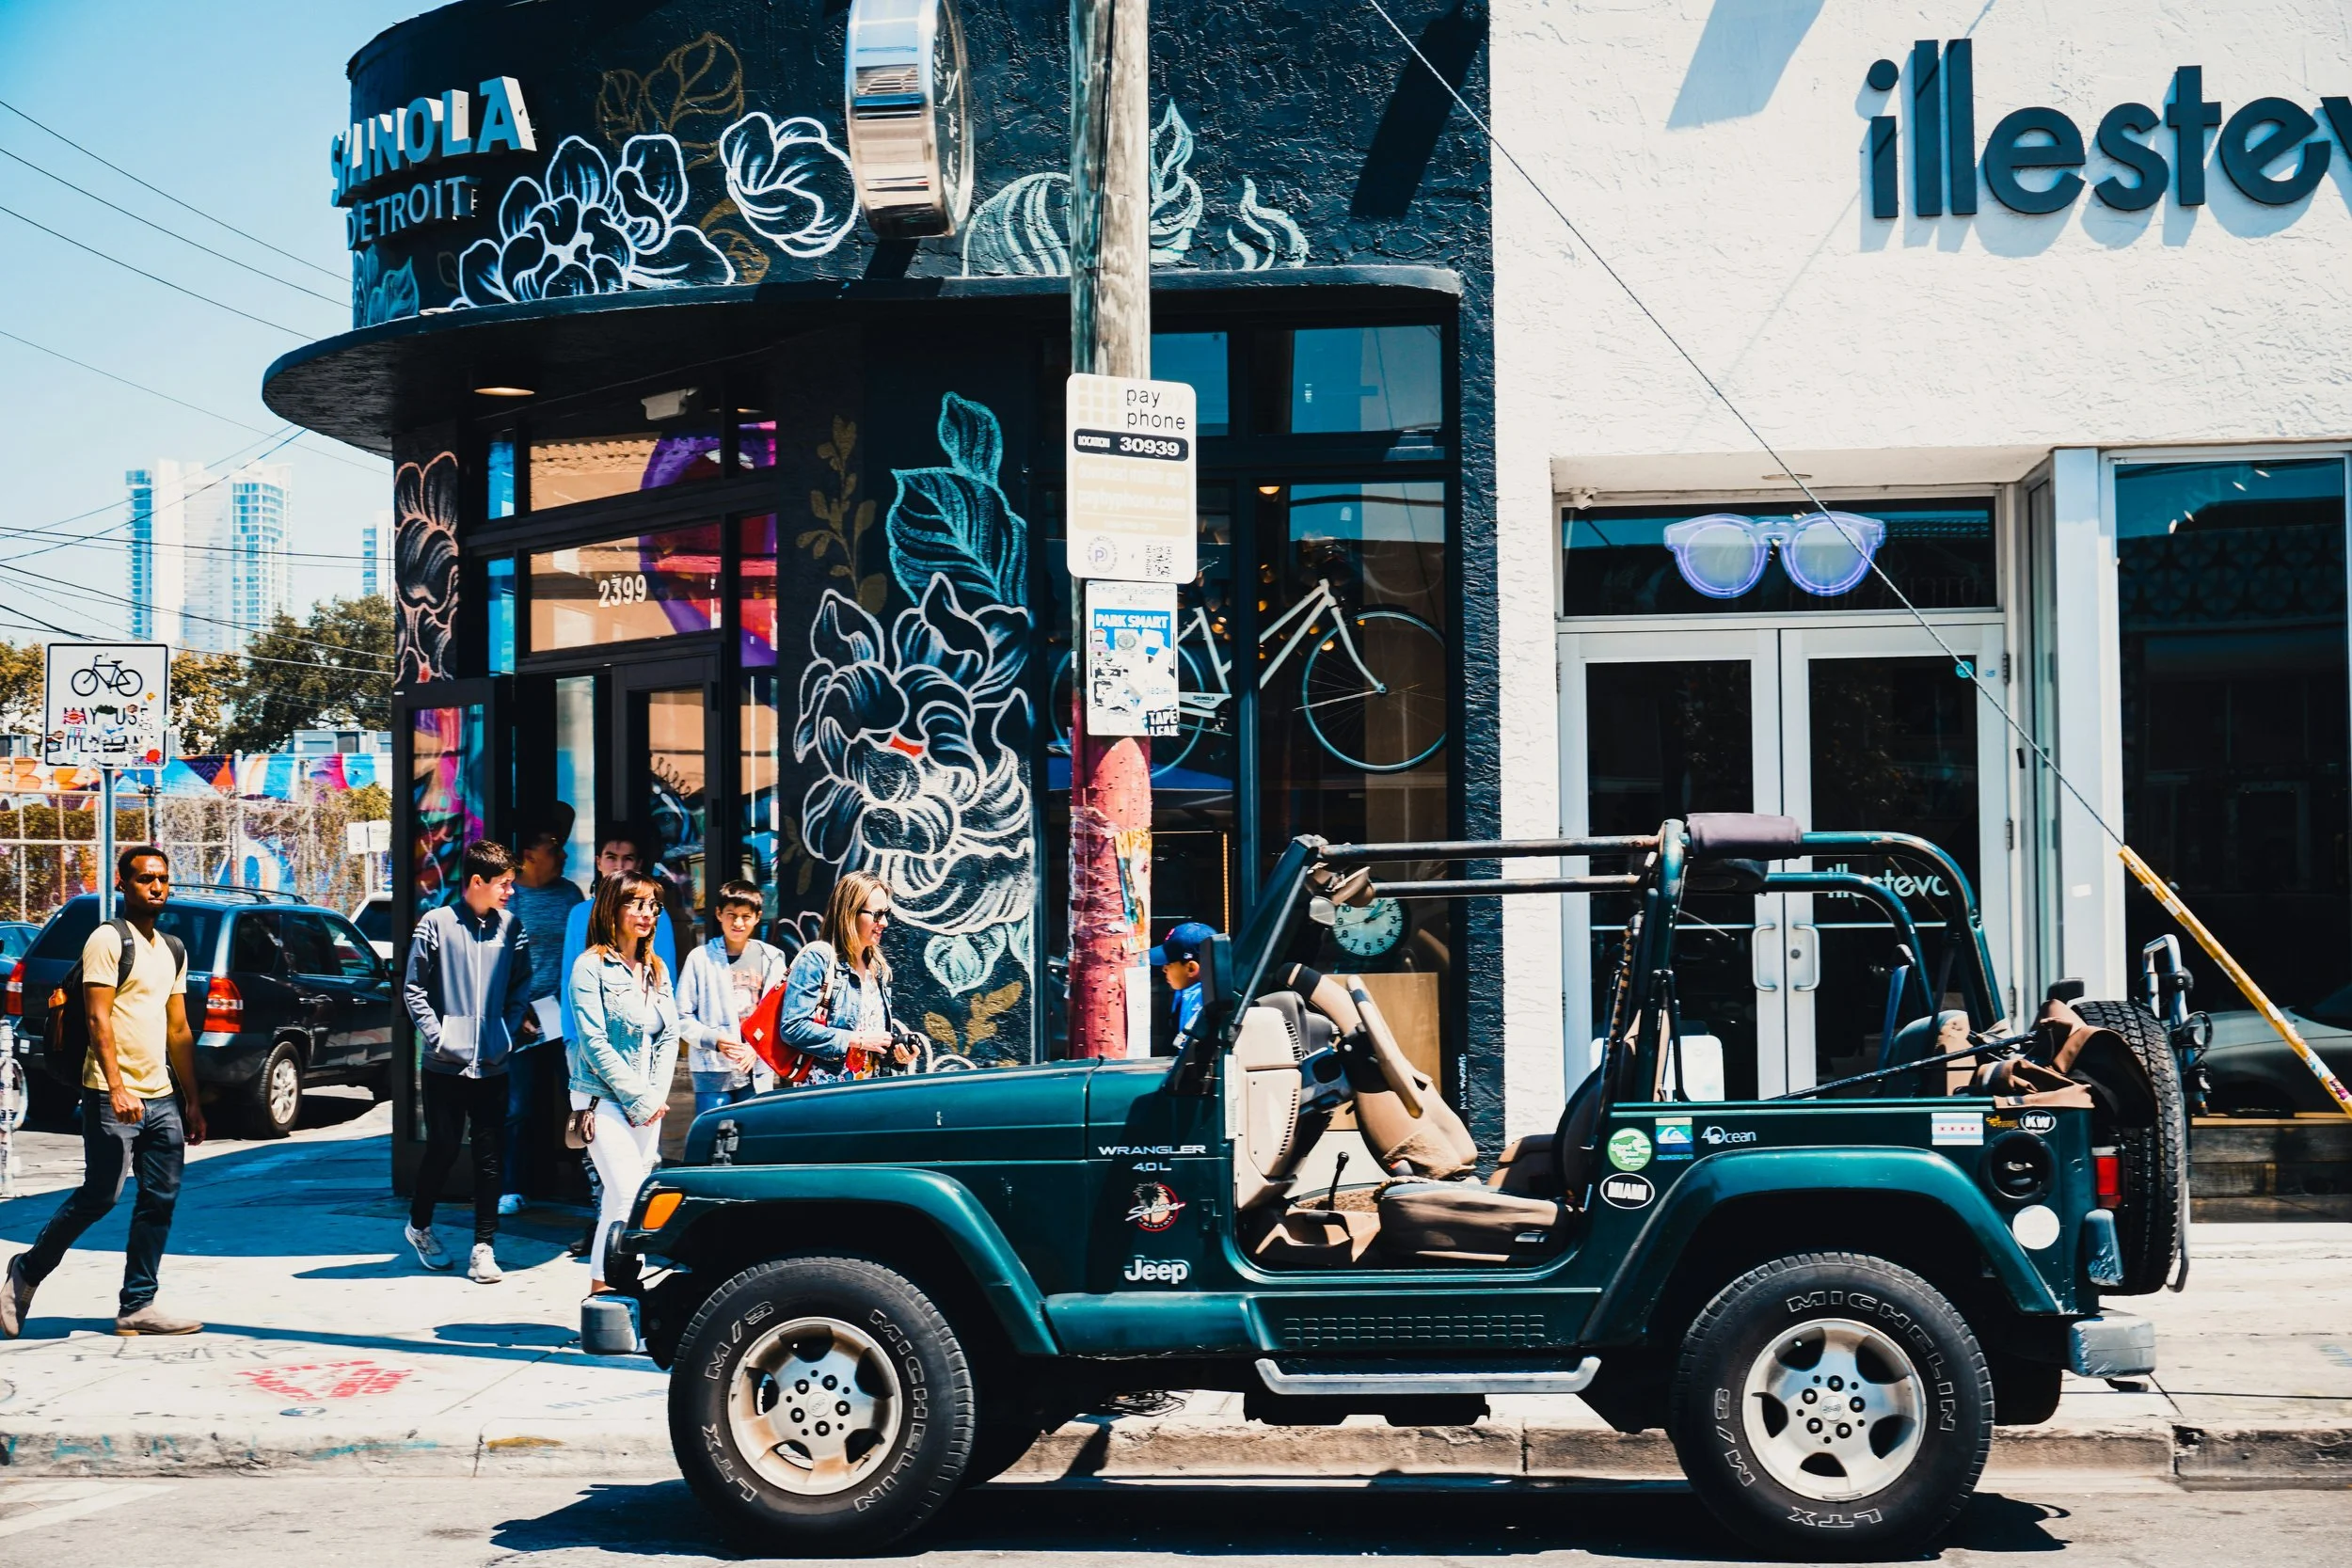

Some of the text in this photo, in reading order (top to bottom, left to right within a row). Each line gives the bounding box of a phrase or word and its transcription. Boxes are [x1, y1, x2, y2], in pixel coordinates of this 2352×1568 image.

[331, 76, 537, 207] SHINOLA
[345, 175, 477, 250] DETROIT
[1126, 388, 1161, 408] pay
[1126, 408, 1185, 430] phone
[1120, 436, 1180, 456] 30939
[598, 574, 647, 608] 2399
[1095, 613, 1168, 629] PARK SMART
[2025, 1116, 2051, 1129] KW
[1098, 1145, 1206, 1156] WRANGLER
[1607, 1181, 1647, 1201] MIAMI
[1124, 1259, 1188, 1284] Jeep
[704, 1300, 775, 1381] M/S
[1786, 1291, 1956, 1433] MICHELIN
[852, 1308, 930, 1513] MICHELIN
[1713, 1387, 1756, 1487] M/S
[702, 1423, 758, 1503] LTX
[1788, 1506, 1883, 1528] LTX
